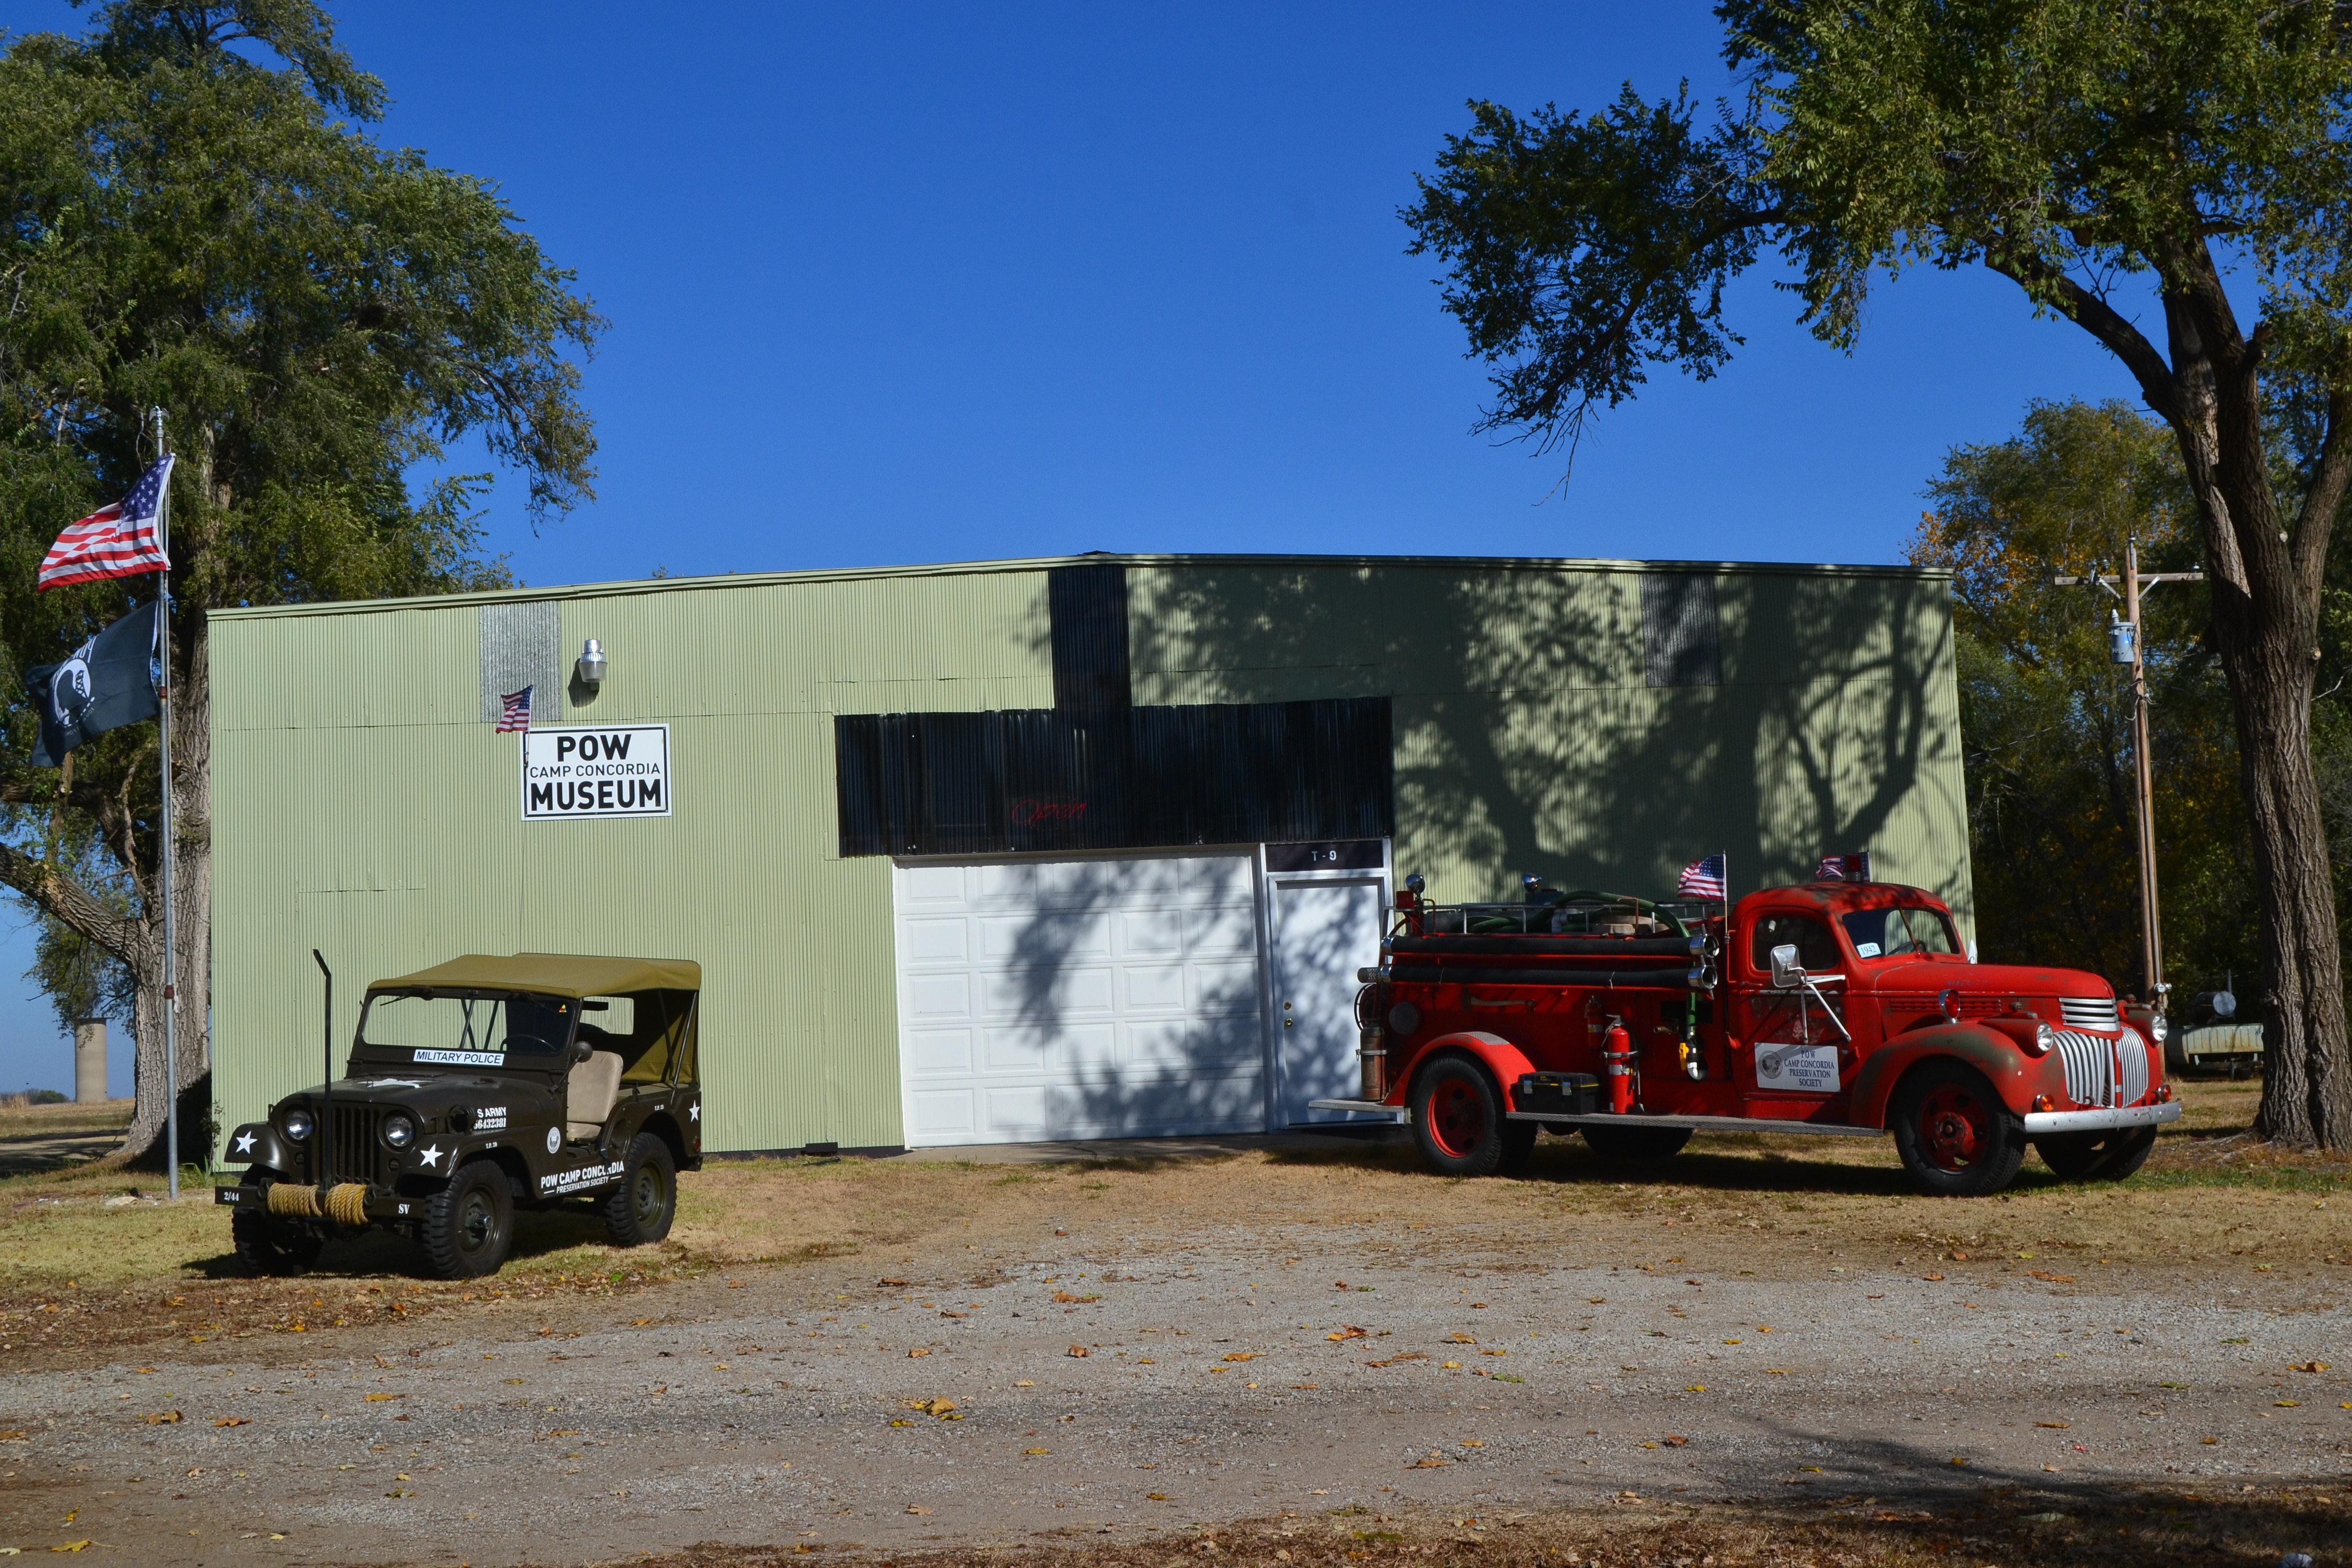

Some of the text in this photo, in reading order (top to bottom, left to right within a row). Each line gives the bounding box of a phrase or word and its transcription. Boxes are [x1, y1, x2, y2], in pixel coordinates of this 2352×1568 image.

[557, 734, 631, 762] POW
[530, 763, 660, 778] CAMP CONCORDIA
[531, 779, 661, 811] MUSEUM
[1860, 945, 1877, 954] 1942
[416, 1051, 501, 1064] MILITARY POLICE
[1801, 1050, 1816, 1058] POW
[1784, 1059, 1834, 1069] CAMP CONCORDIA
[1790, 1068, 1831, 1078] PRESERVATION
[1799, 1078, 1822, 1087] SOCIETY
[485, 1107, 506, 1117] ARMY
[541, 1174, 558, 1189] POW
[559, 1169, 581, 1185] CAMP
[556, 1176, 609, 1194] PRESERVATION SOCIETY
[224, 1191, 239, 1201] 2/44
[398, 1204, 410, 1214] SV
